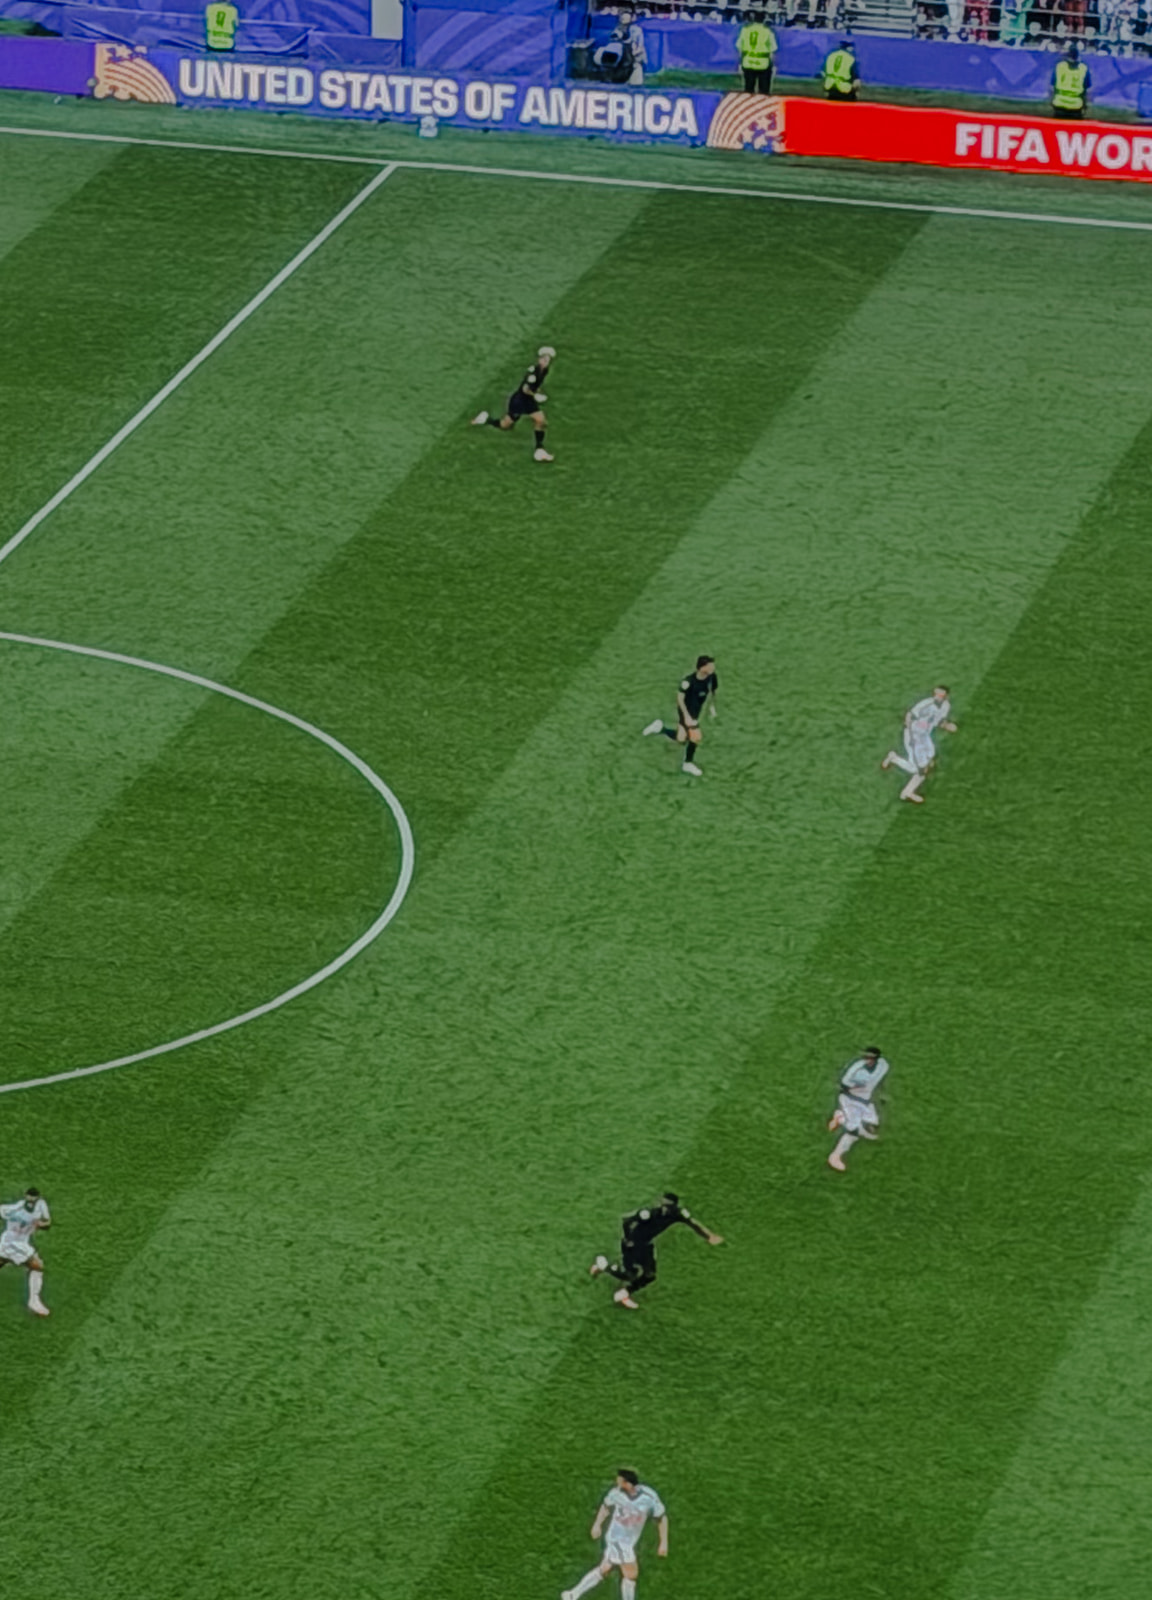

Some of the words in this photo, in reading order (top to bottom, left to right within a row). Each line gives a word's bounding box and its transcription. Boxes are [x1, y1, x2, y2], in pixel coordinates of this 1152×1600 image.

[178, 58, 314, 105] UNITED
[319, 69, 459, 117] STATES
[464, 80, 517, 121] OF
[518, 86, 699, 137] AMERICA
[955, 122, 1050, 163] FIFA
[1055, 130, 1152, 172] WOR
